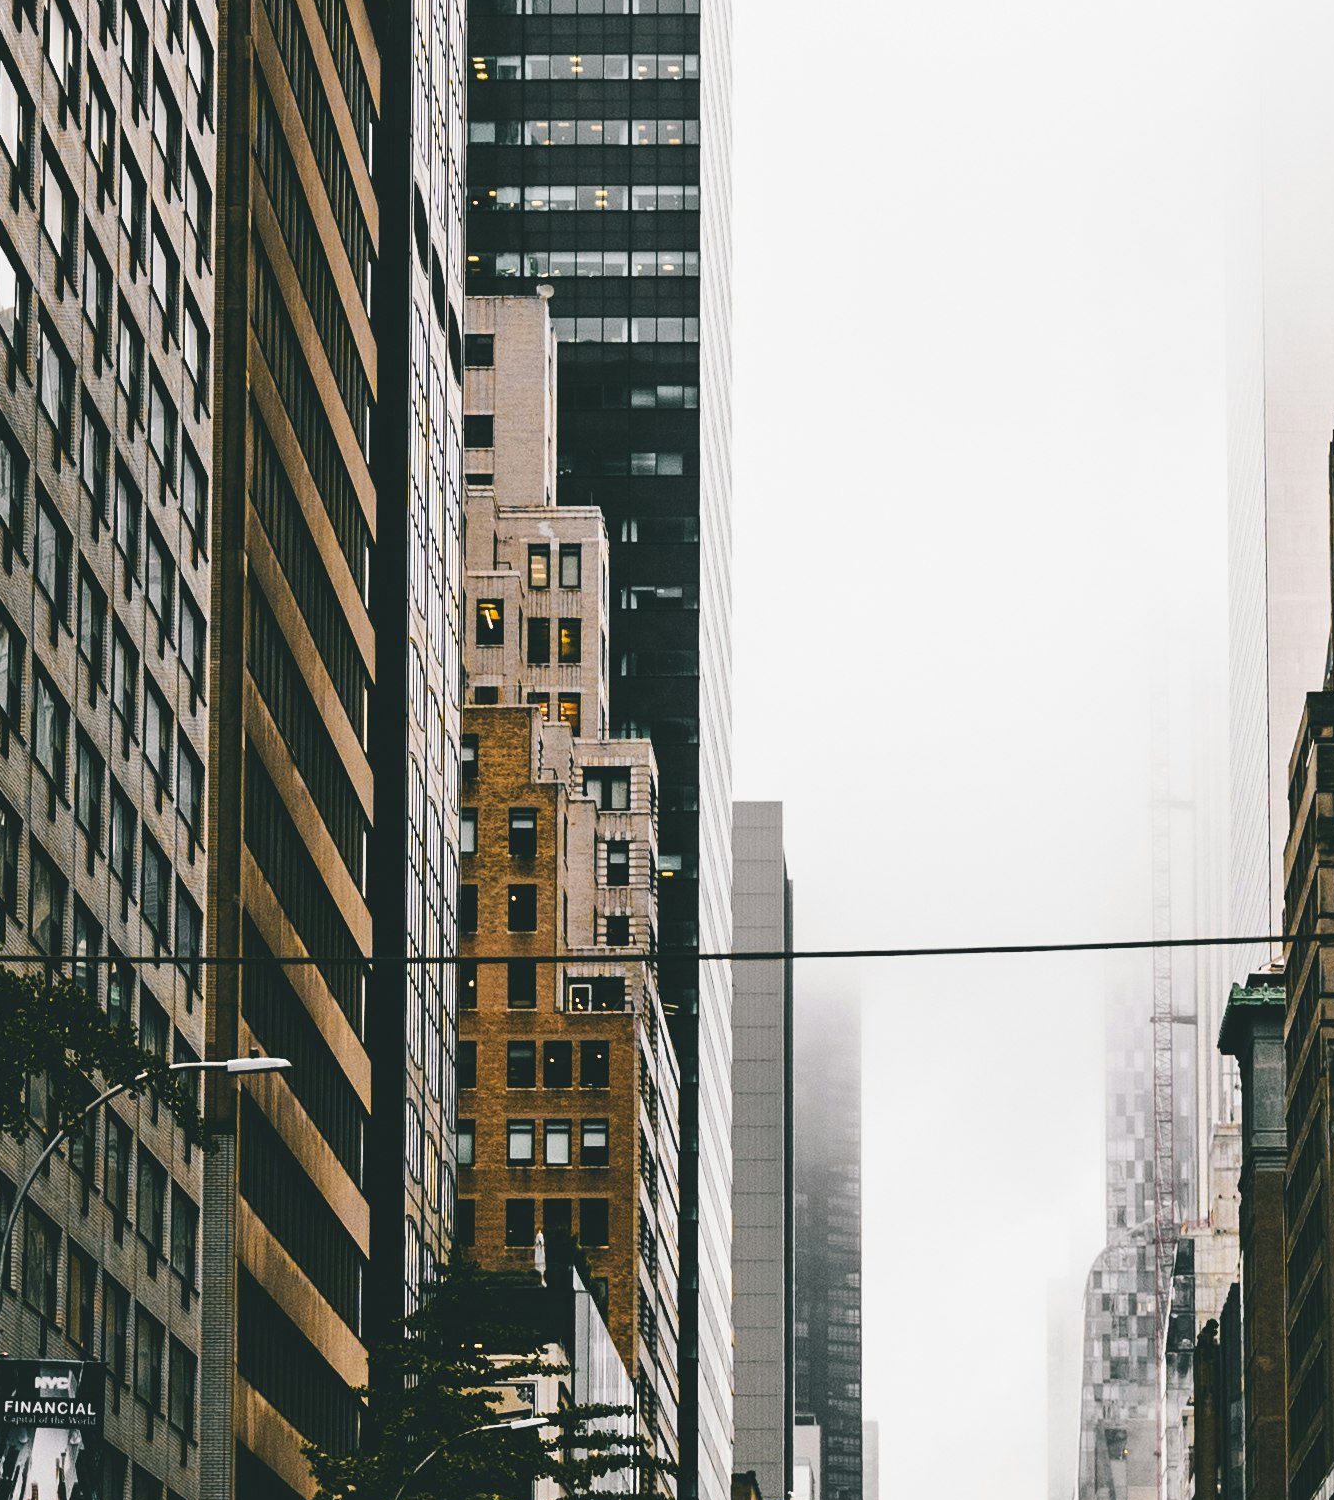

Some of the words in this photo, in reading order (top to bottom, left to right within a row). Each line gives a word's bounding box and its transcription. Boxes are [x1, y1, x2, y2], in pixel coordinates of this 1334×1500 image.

[34, 1376, 69, 1390] NYC
[4, 1400, 97, 1416] FINANCIAL
[3, 1415, 36, 1425] Capital
[38, 1416, 48, 1424] of
[50, 1416, 65, 1424] the
[68, 1416, 97, 1426] World
